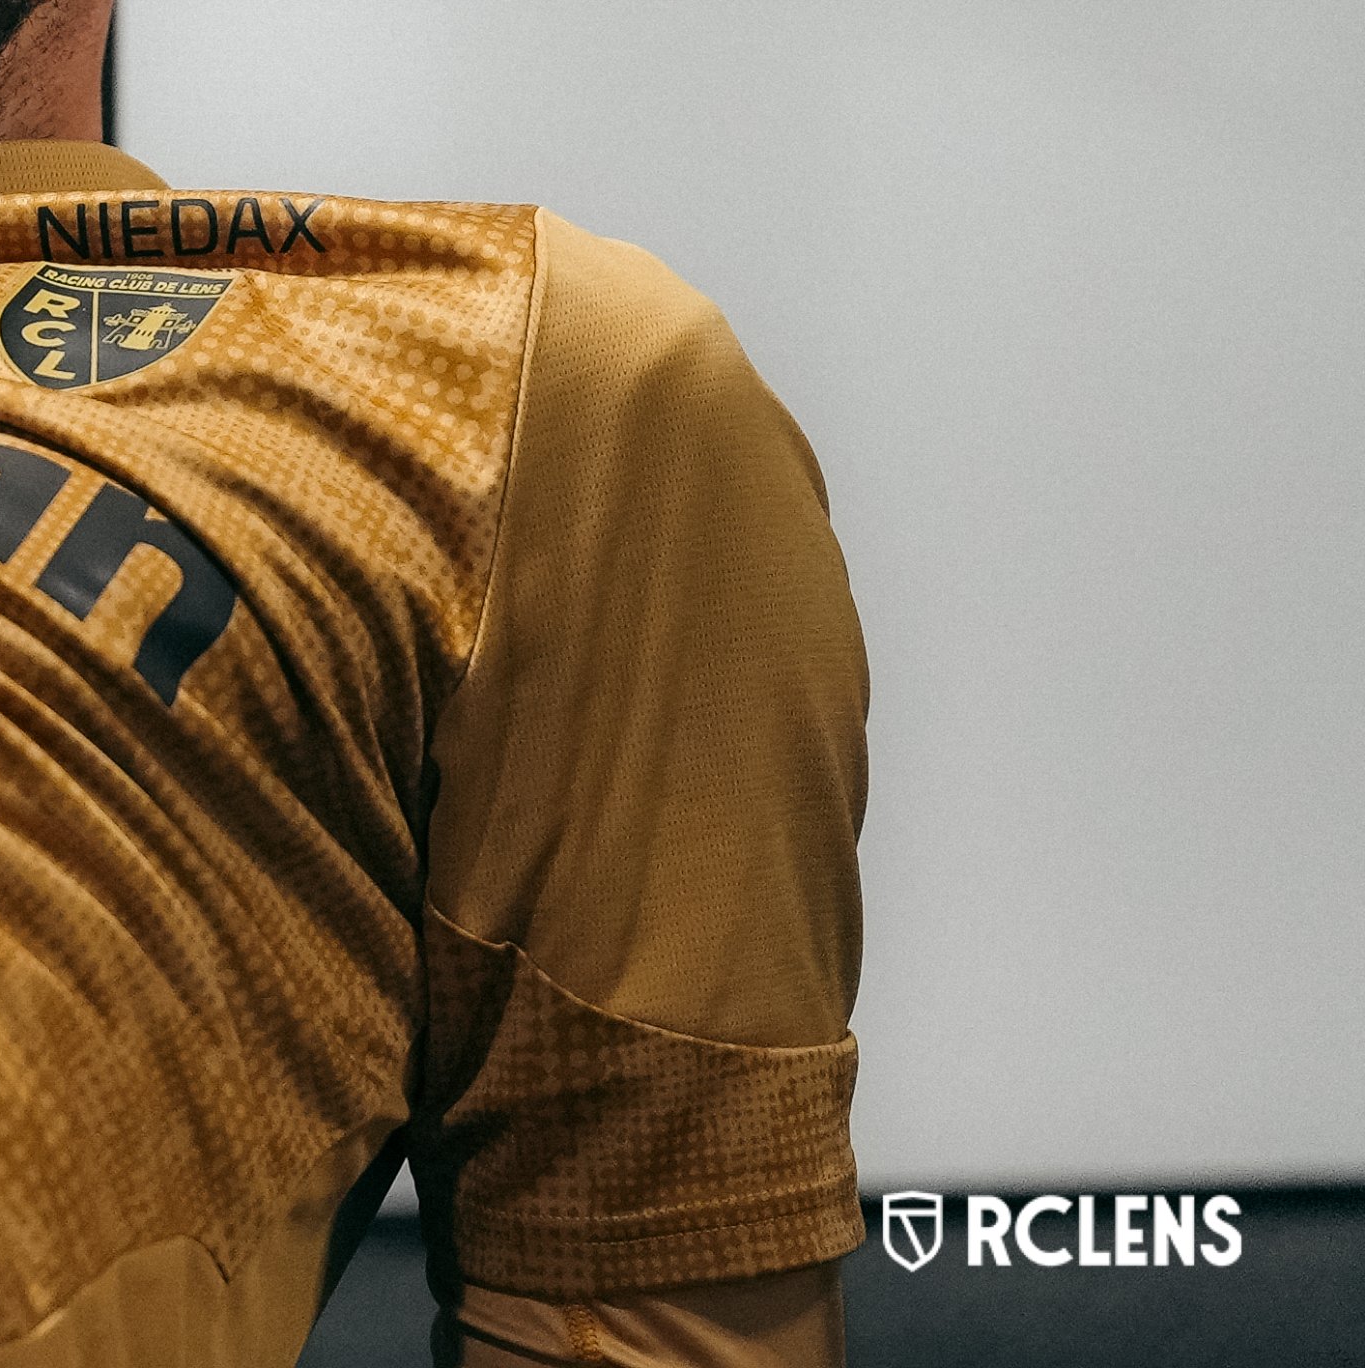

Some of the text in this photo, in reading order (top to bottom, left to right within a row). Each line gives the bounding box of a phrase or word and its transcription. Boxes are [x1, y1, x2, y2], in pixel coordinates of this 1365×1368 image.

[37, 197, 326, 261] NIEDAX
[43, 269, 225, 295] RACING CLUB DE LENS
